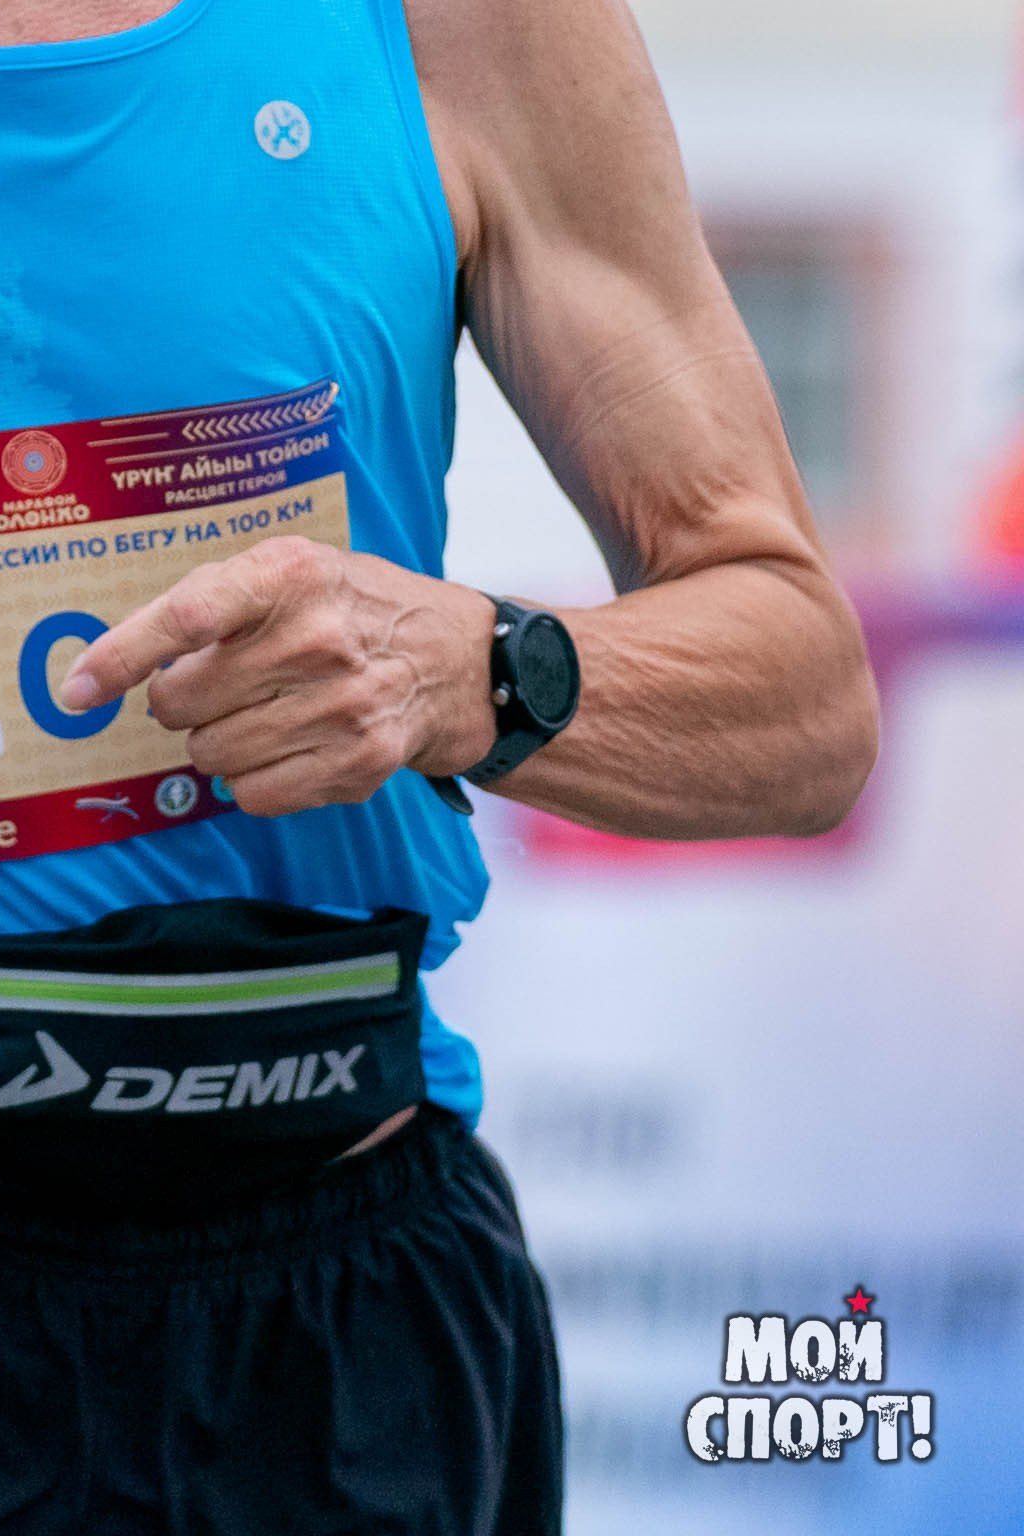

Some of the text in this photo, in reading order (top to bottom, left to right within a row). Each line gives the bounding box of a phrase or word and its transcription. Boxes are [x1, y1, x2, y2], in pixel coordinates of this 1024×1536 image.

[180, 455, 252, 481] АЙЫЫ
[256, 432, 330, 466] ТОЙОН
[165, 470, 287, 505] РАСЦВЕТ ГЕРОЯ
[67, 537, 107, 560] ПО
[115, 526, 177, 555] БЕГУ
[185, 521, 221, 543] НА
[228, 509, 271, 534] 100
[277, 496, 314, 522] КМ
[90, 1044, 366, 1113] DEMIX
